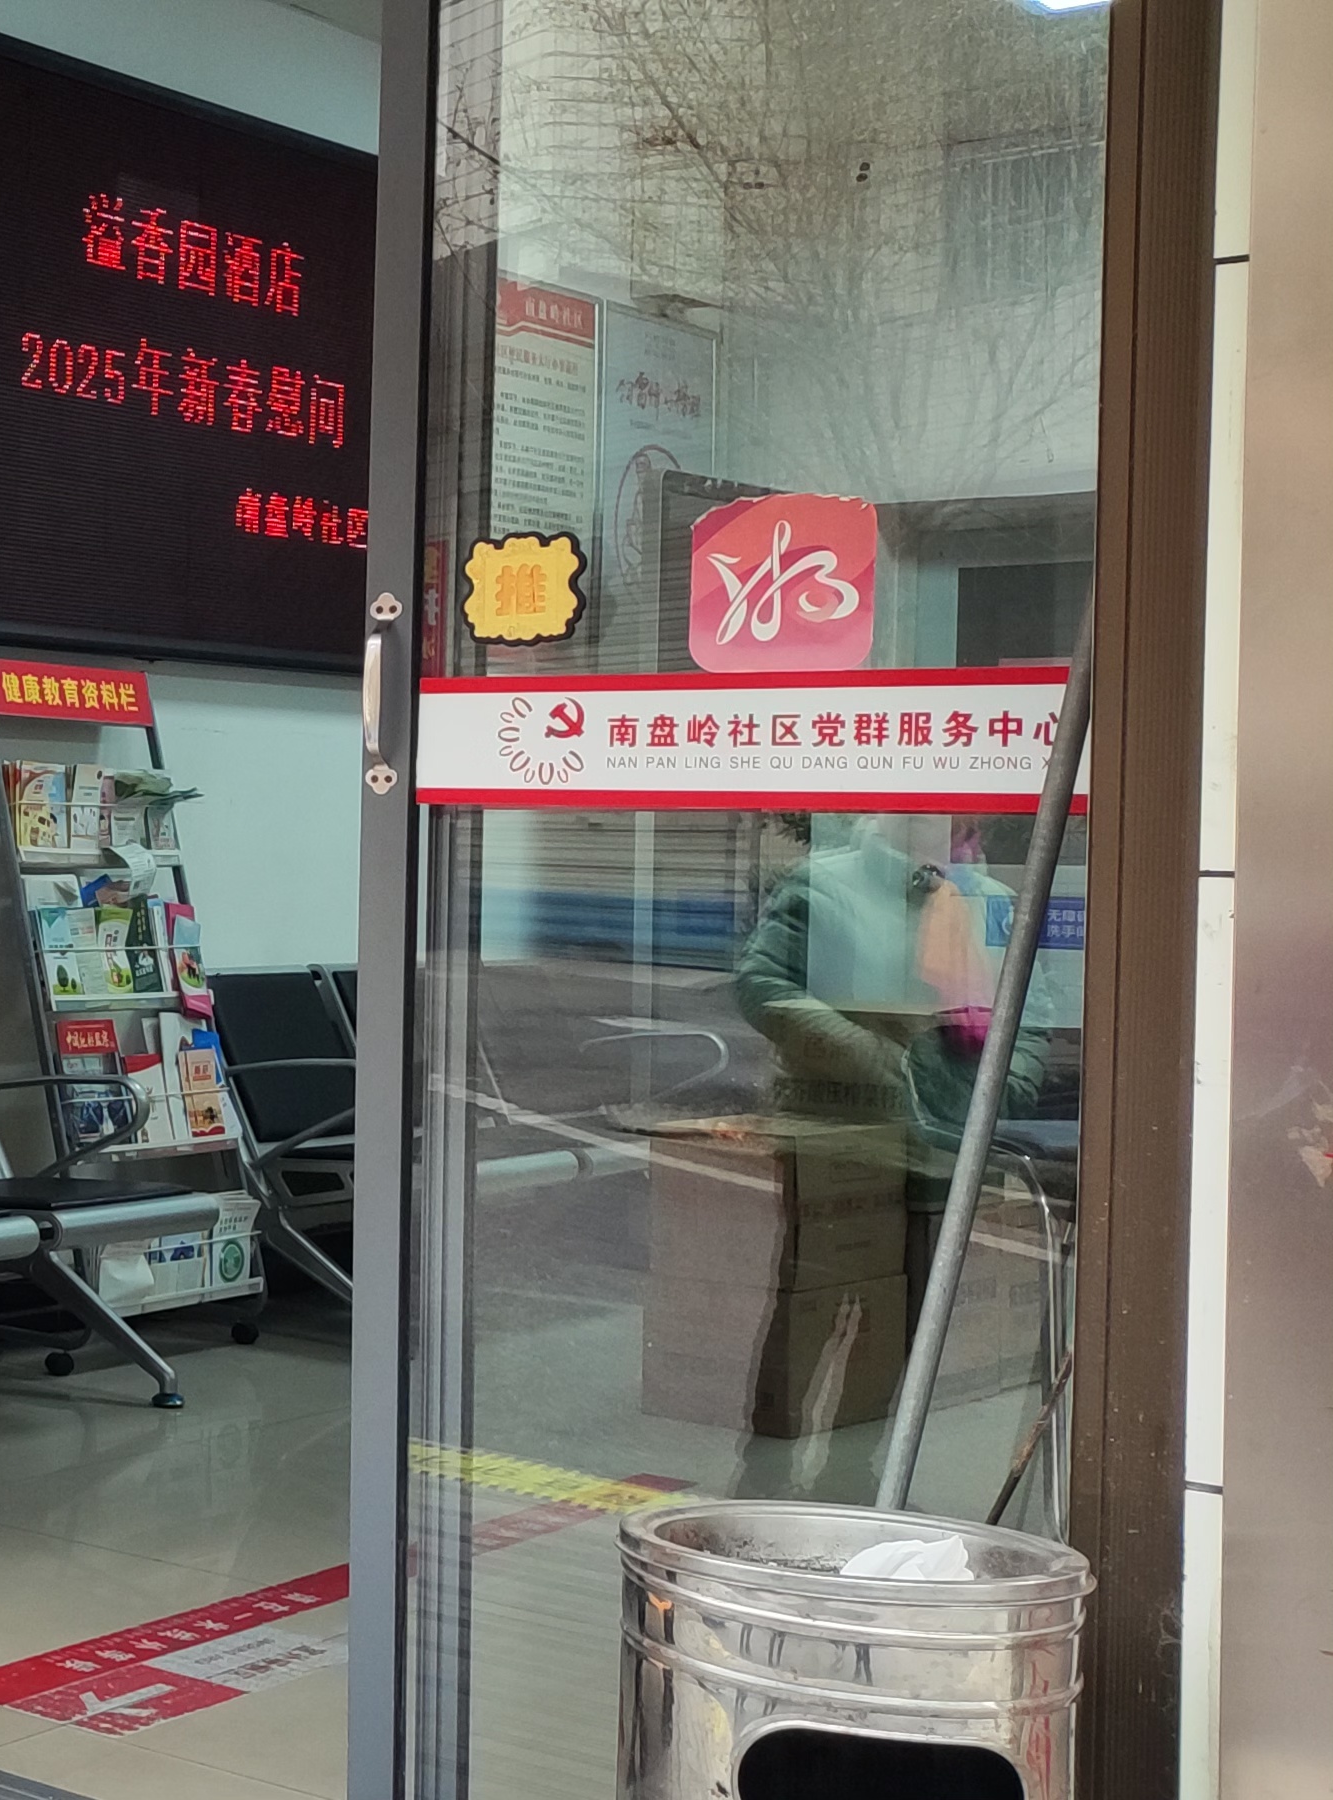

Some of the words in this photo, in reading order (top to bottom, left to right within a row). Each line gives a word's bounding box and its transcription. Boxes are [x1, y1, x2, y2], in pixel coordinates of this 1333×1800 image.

[82, 193, 305, 317] 溢香园酒店
[21, 332, 346, 448] 2025年新春慰问
[235, 487, 369, 548] 南盘岭社区
[1, 671, 139, 712] 健康教育资料栏
[607, 710, 1060, 748] 南盘岭社区党群服务中心
[606, 756, 638, 769] NAN
[646, 756, 677, 769] PAN
[685, 756, 721, 769] LING
[729, 756, 761, 769] SHE
[770, 756, 793, 770] QU
[801, 756, 848, 770] DANG
[857, 756, 893, 770] QUN
[902, 756, 924, 769] FU
[933, 756, 960, 769] WU
[969, 756, 1032, 769] ZHONG
